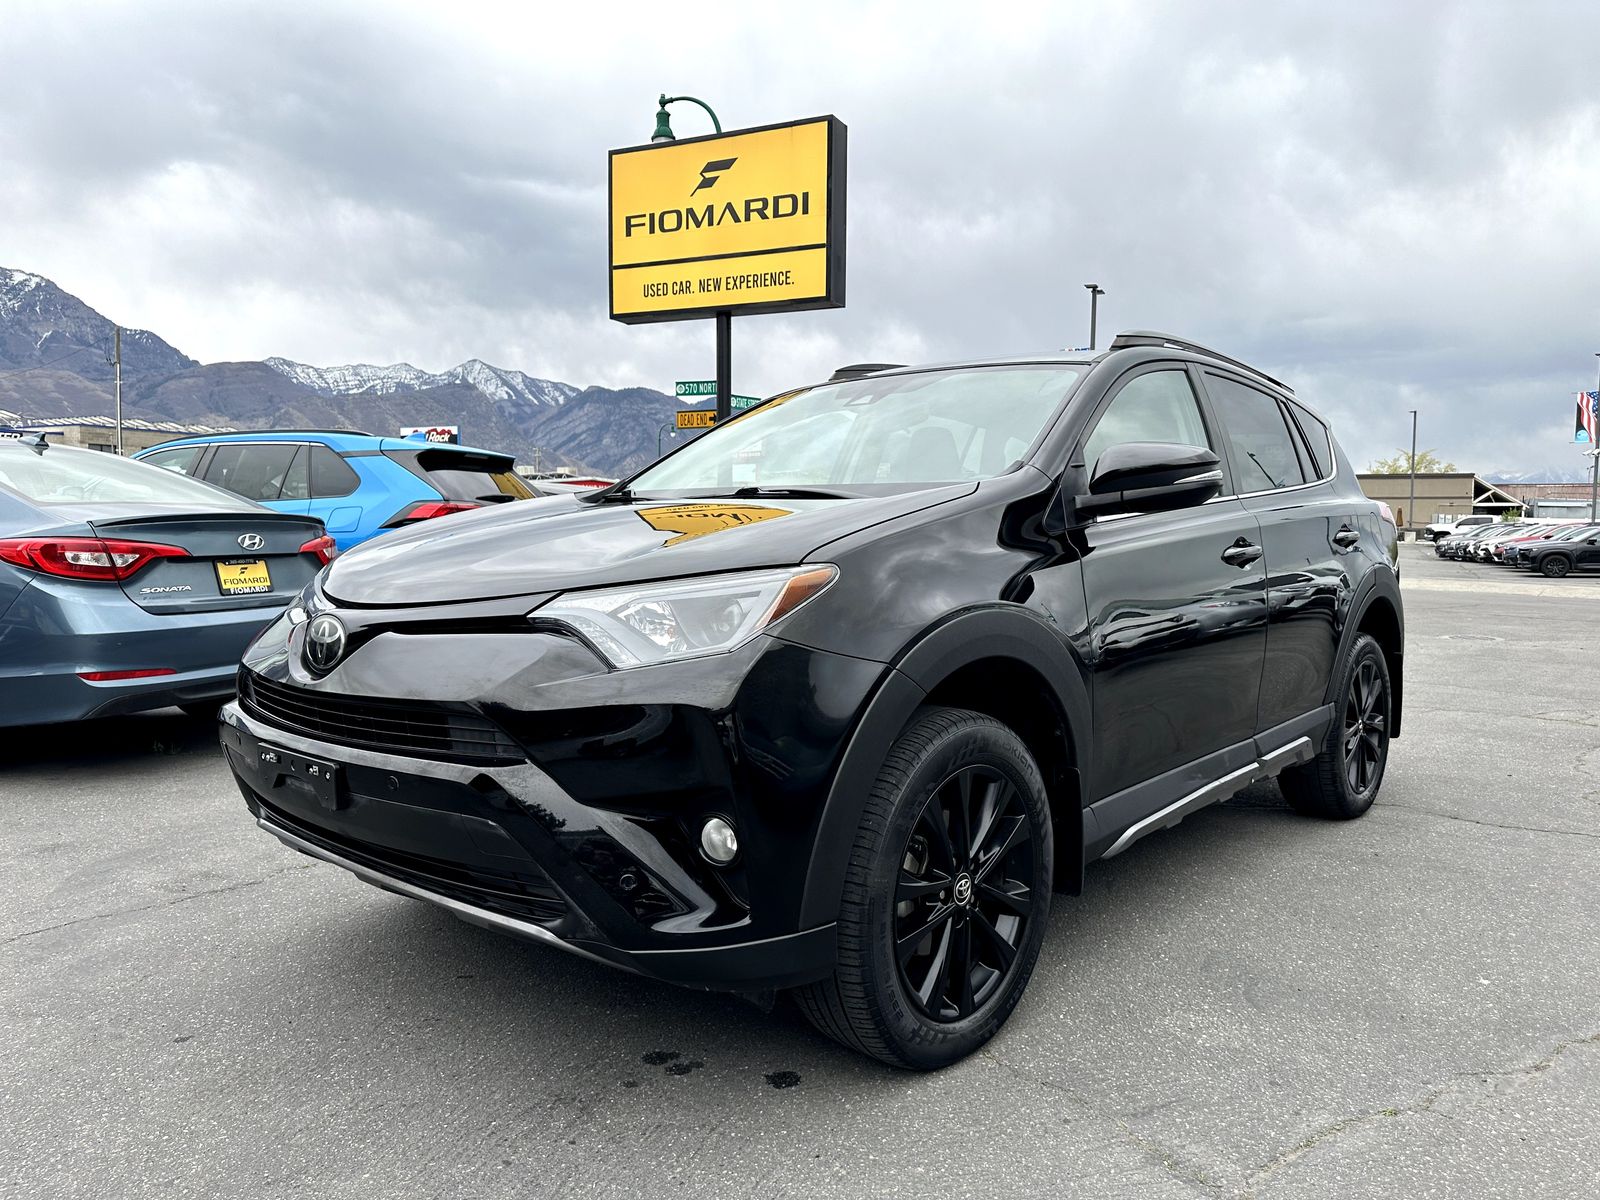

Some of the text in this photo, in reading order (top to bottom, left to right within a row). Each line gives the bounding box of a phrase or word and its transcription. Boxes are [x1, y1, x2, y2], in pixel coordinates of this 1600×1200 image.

[625, 192, 809, 237] FIOMARDI
[643, 270, 795, 298] USED CAR. NEW EXPERIENCE.
[685, 383, 717, 394] 570 NORT
[680, 413, 708, 426] DEAD END
[428, 431, 451, 442] Rock
[223, 576, 269, 586] FIOMARDI
[139, 585, 192, 595] SONATA
[230, 585, 269, 595] FIOMARDI
